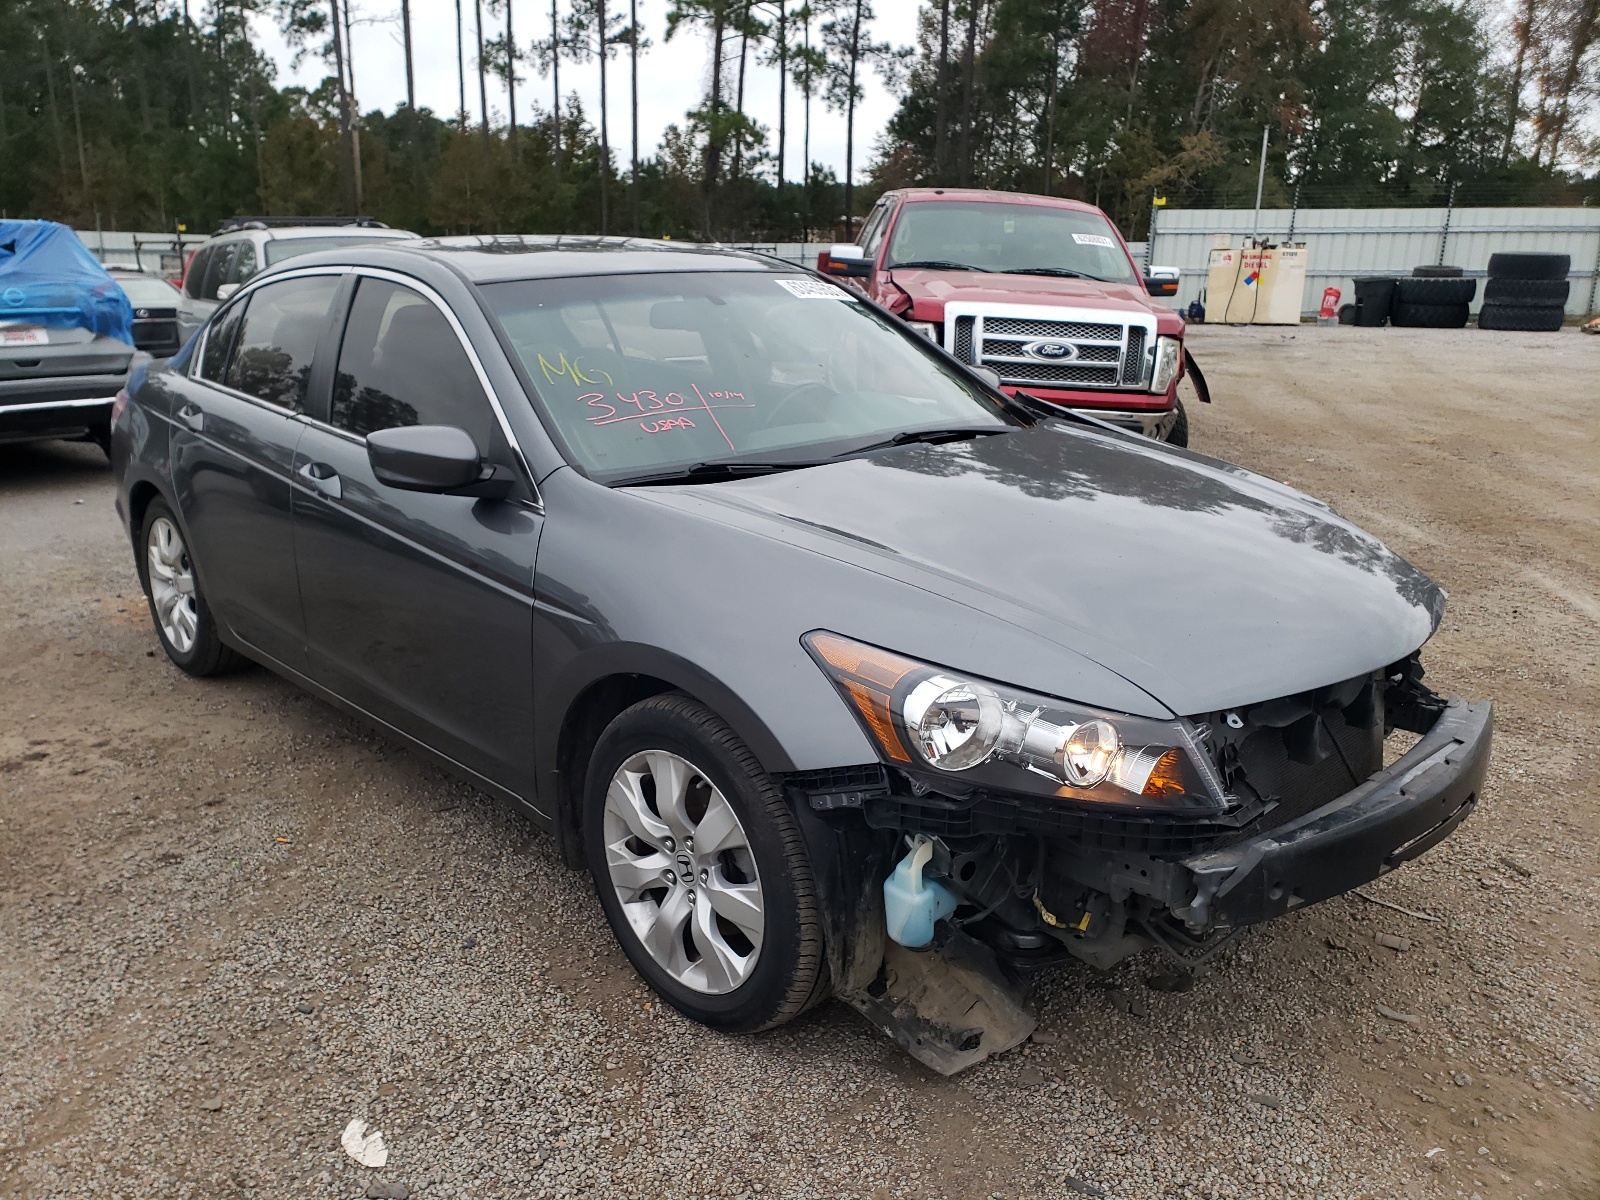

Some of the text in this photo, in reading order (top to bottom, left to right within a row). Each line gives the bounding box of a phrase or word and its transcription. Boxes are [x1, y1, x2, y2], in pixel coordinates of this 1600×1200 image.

[1244, 261, 1268, 269] DIESEL
[1041, 344, 1065, 355] Ford
[577, 390, 684, 421] 3430
